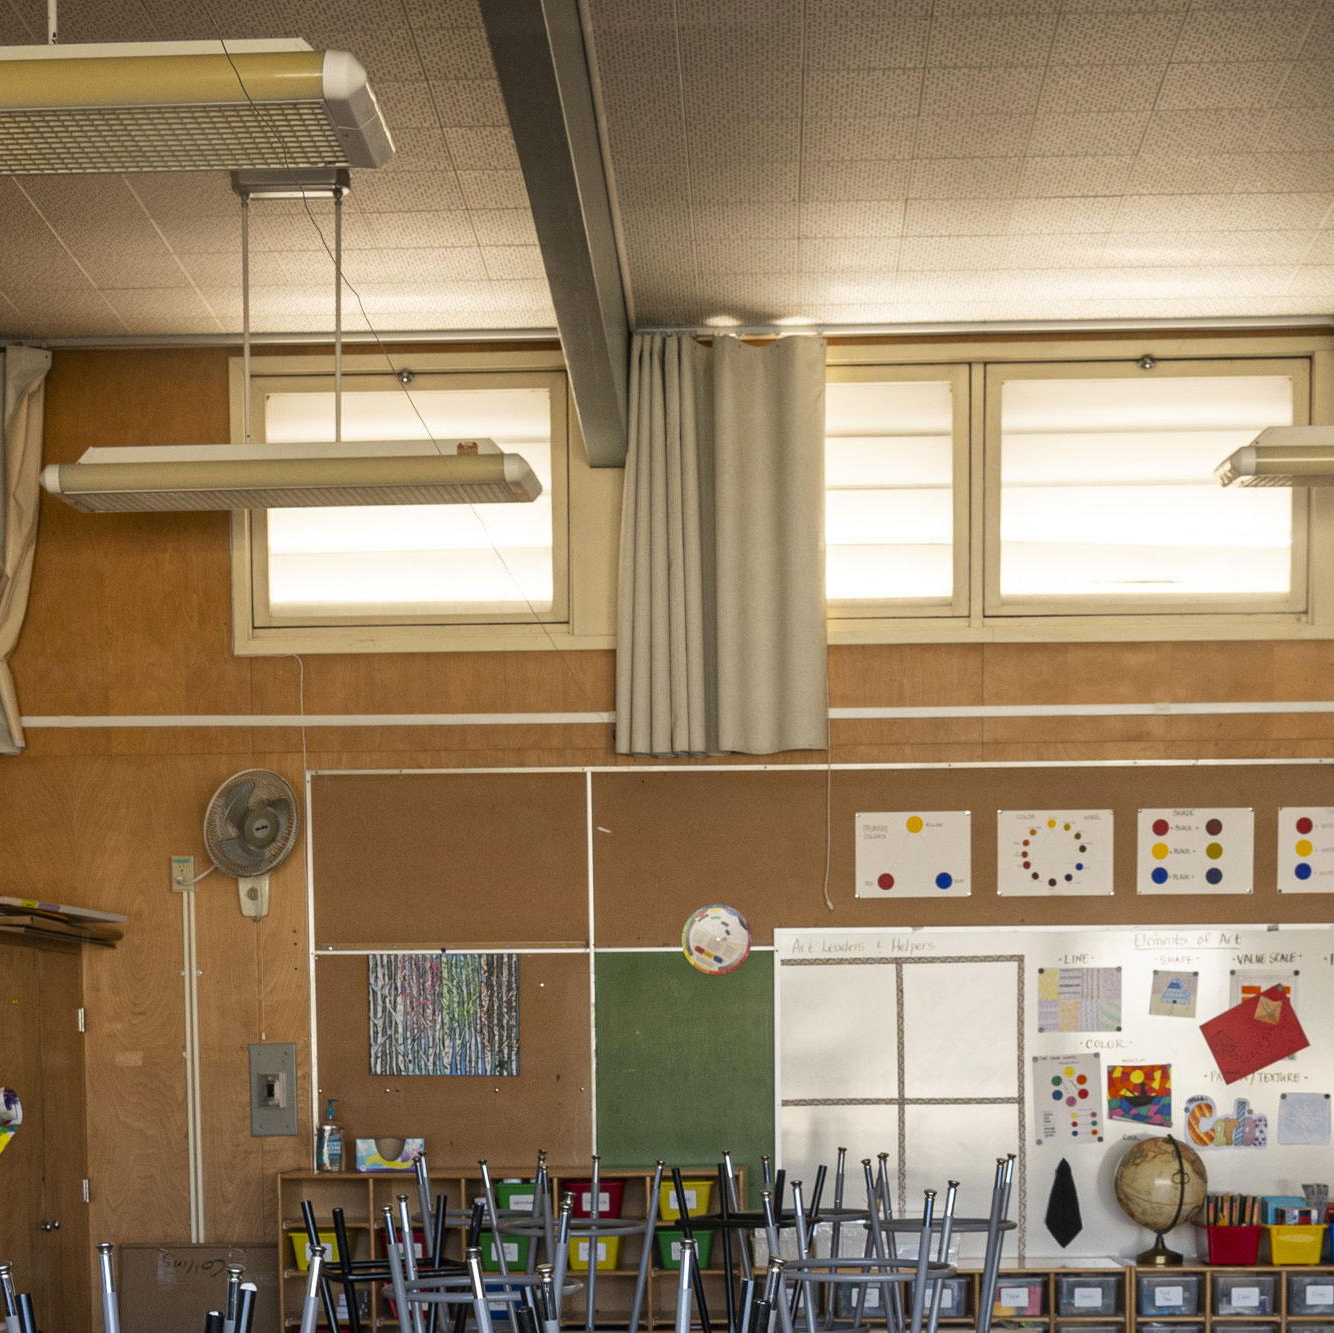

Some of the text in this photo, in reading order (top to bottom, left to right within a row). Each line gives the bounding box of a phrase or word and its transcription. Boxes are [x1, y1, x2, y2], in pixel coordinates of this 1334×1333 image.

[1172, 809, 1194, 818] SHADE
[1175, 824, 1193, 832] BLACK
[1173, 847, 1192, 856] BLACK
[1172, 873, 1191, 881] BLACK
[792, 937, 936, 955] Art Leaders Helpers
[1133, 932, 1244, 948] Elements of Art
[1064, 953, 1090, 965] LINE
[1160, 954, 1192, 966] SHAPE
[1236, 953, 1298, 965] VALUE SCALE
[1085, 1038, 1127, 1050] COLOR
